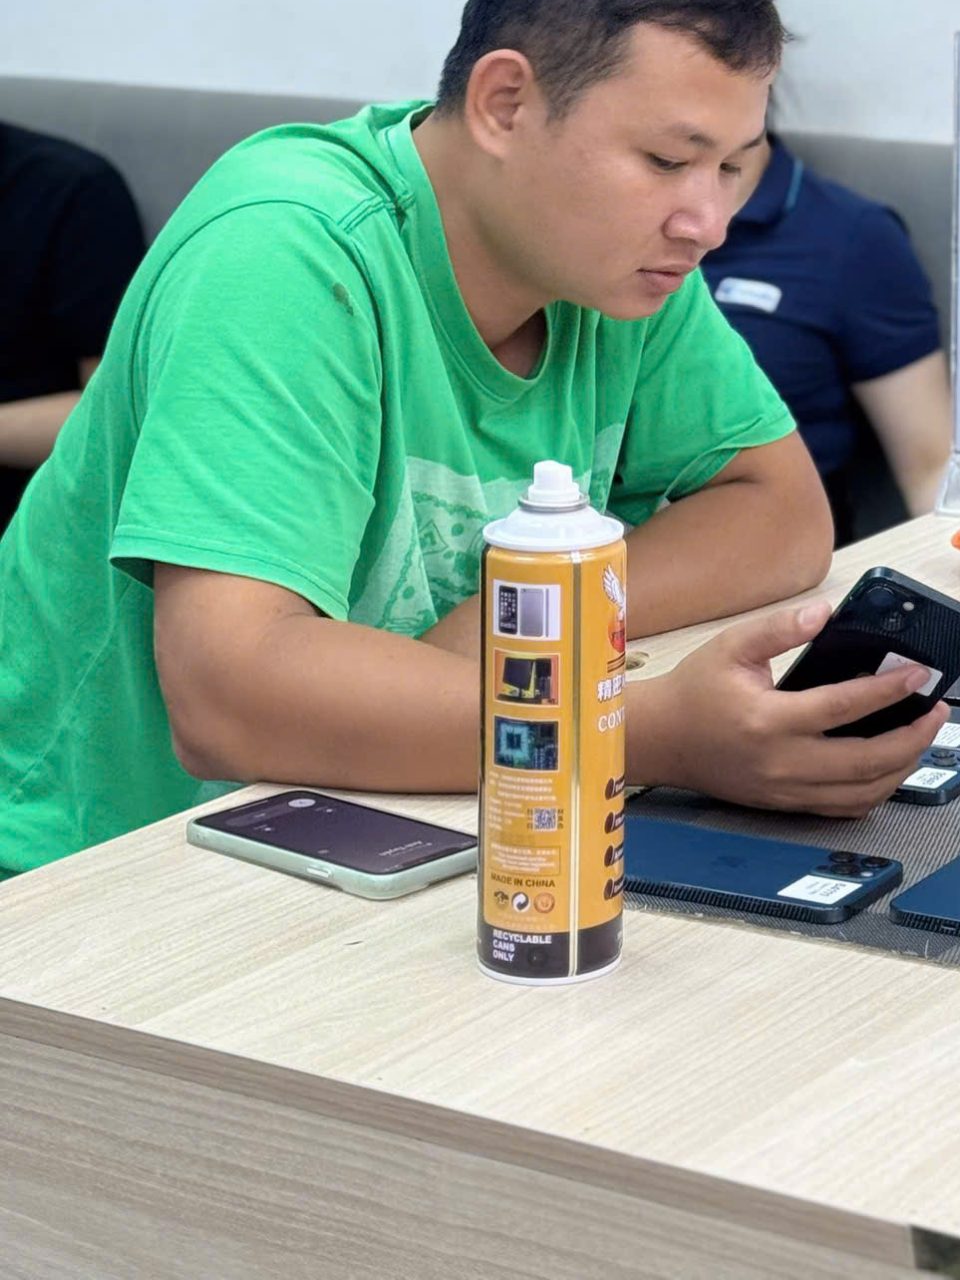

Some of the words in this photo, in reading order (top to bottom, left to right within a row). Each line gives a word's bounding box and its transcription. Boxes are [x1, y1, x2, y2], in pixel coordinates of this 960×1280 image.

[490, 872, 512, 885] MADE
[513, 878, 523, 887] IN
[525, 879, 556, 888] CHINA
[492, 929, 553, 945] RECYCLABLE
[492, 939, 516, 952] CANS
[492, 949, 515, 962] ONLY
